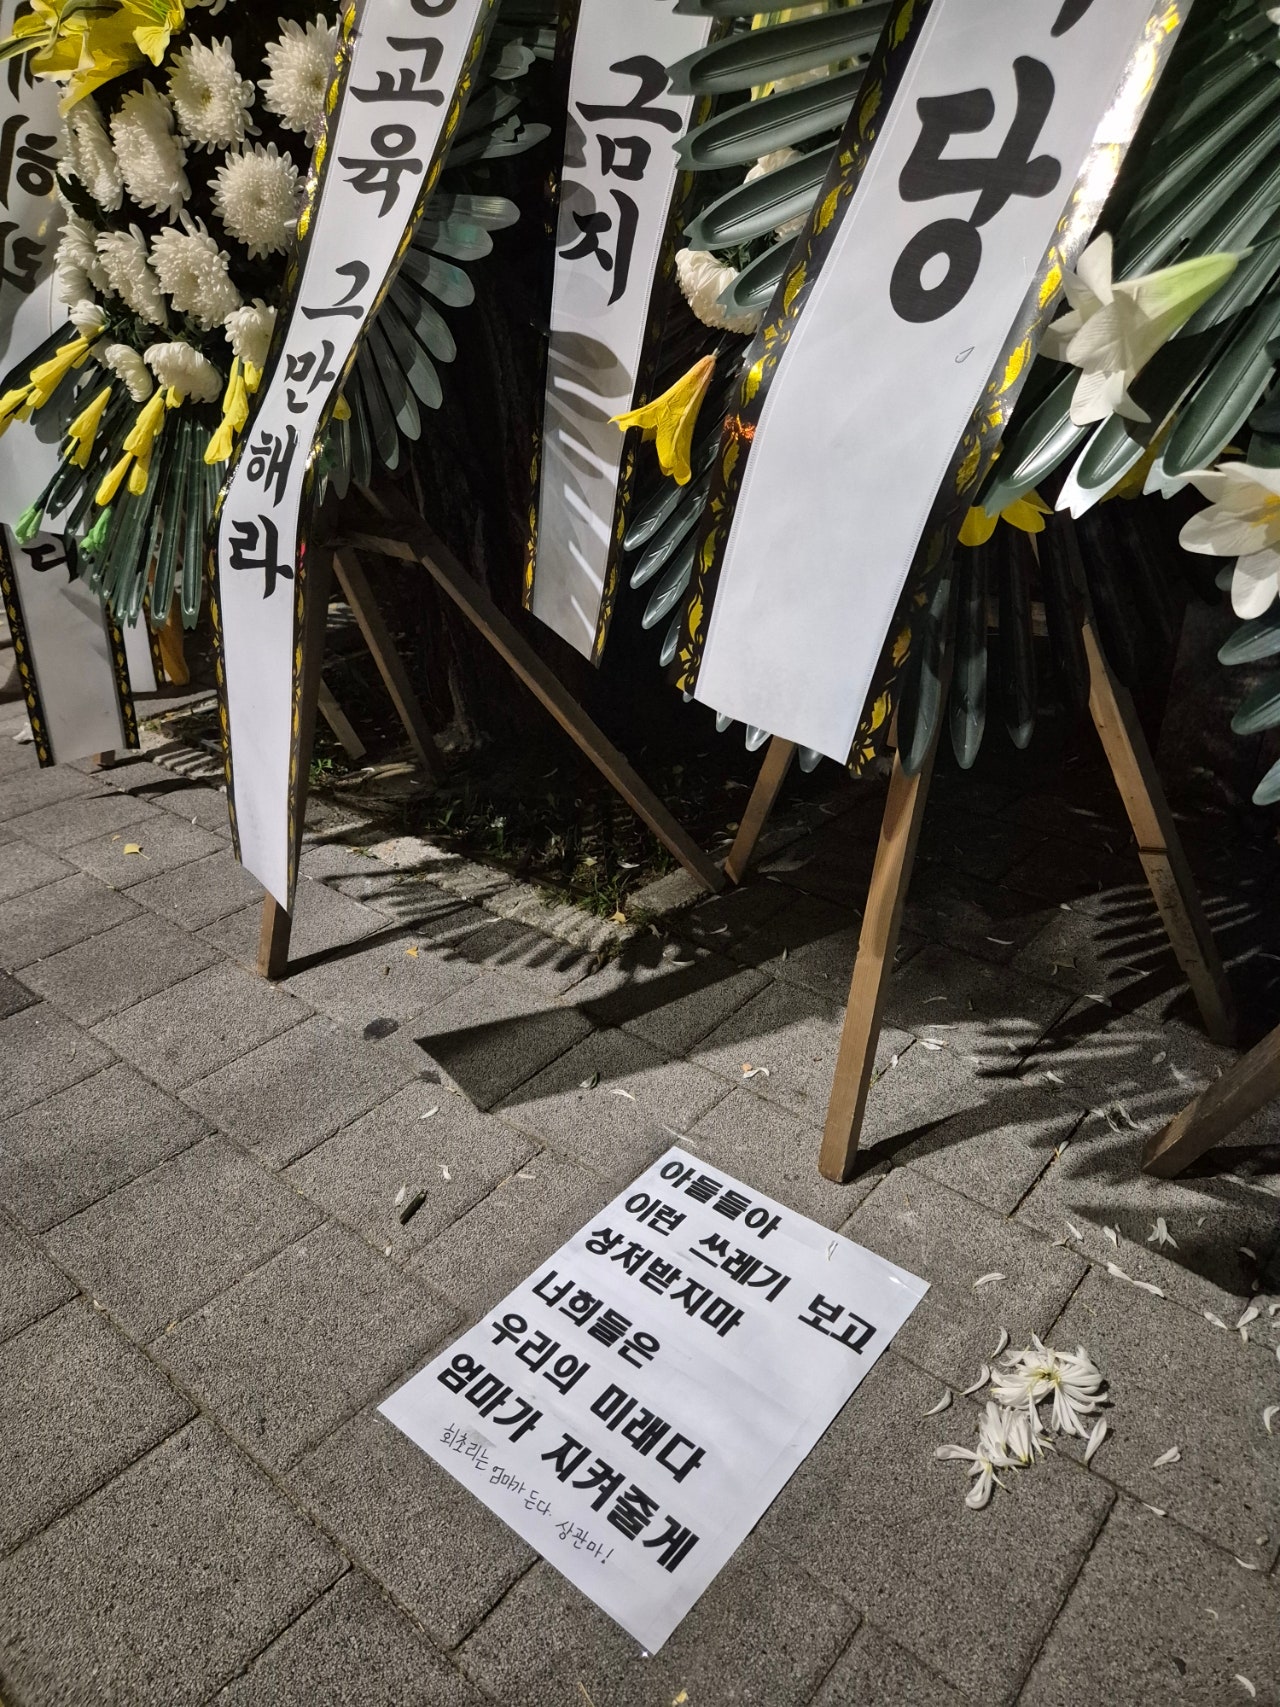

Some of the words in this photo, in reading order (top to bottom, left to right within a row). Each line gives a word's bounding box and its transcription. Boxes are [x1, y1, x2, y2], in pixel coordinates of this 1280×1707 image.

[558, 55, 683, 306] 금지
[890, 0, 1096, 323] 당
[228, 261, 365, 600] 그만해라
[586, 1228, 745, 1337] 상처받지마
[625, 1193, 687, 1236] 이런
[689, 1233, 791, 1302] 쓰레기
[798, 1294, 877, 1355] 보고
[661, 1162, 782, 1239] 아들들아
[492, 1314, 590, 1395] 우리의
[590, 1384, 706, 1483] 미래다
[532, 1271, 660, 1369] 너희들은
[437, 1354, 543, 1442] 엄마가
[541, 1433, 699, 1573] 지켜줄게
[440, 1423, 489, 1470] 회초리는
[489, 1466, 526, 1494] 엄마가
[555, 1521, 614, 1564] 상관마!
